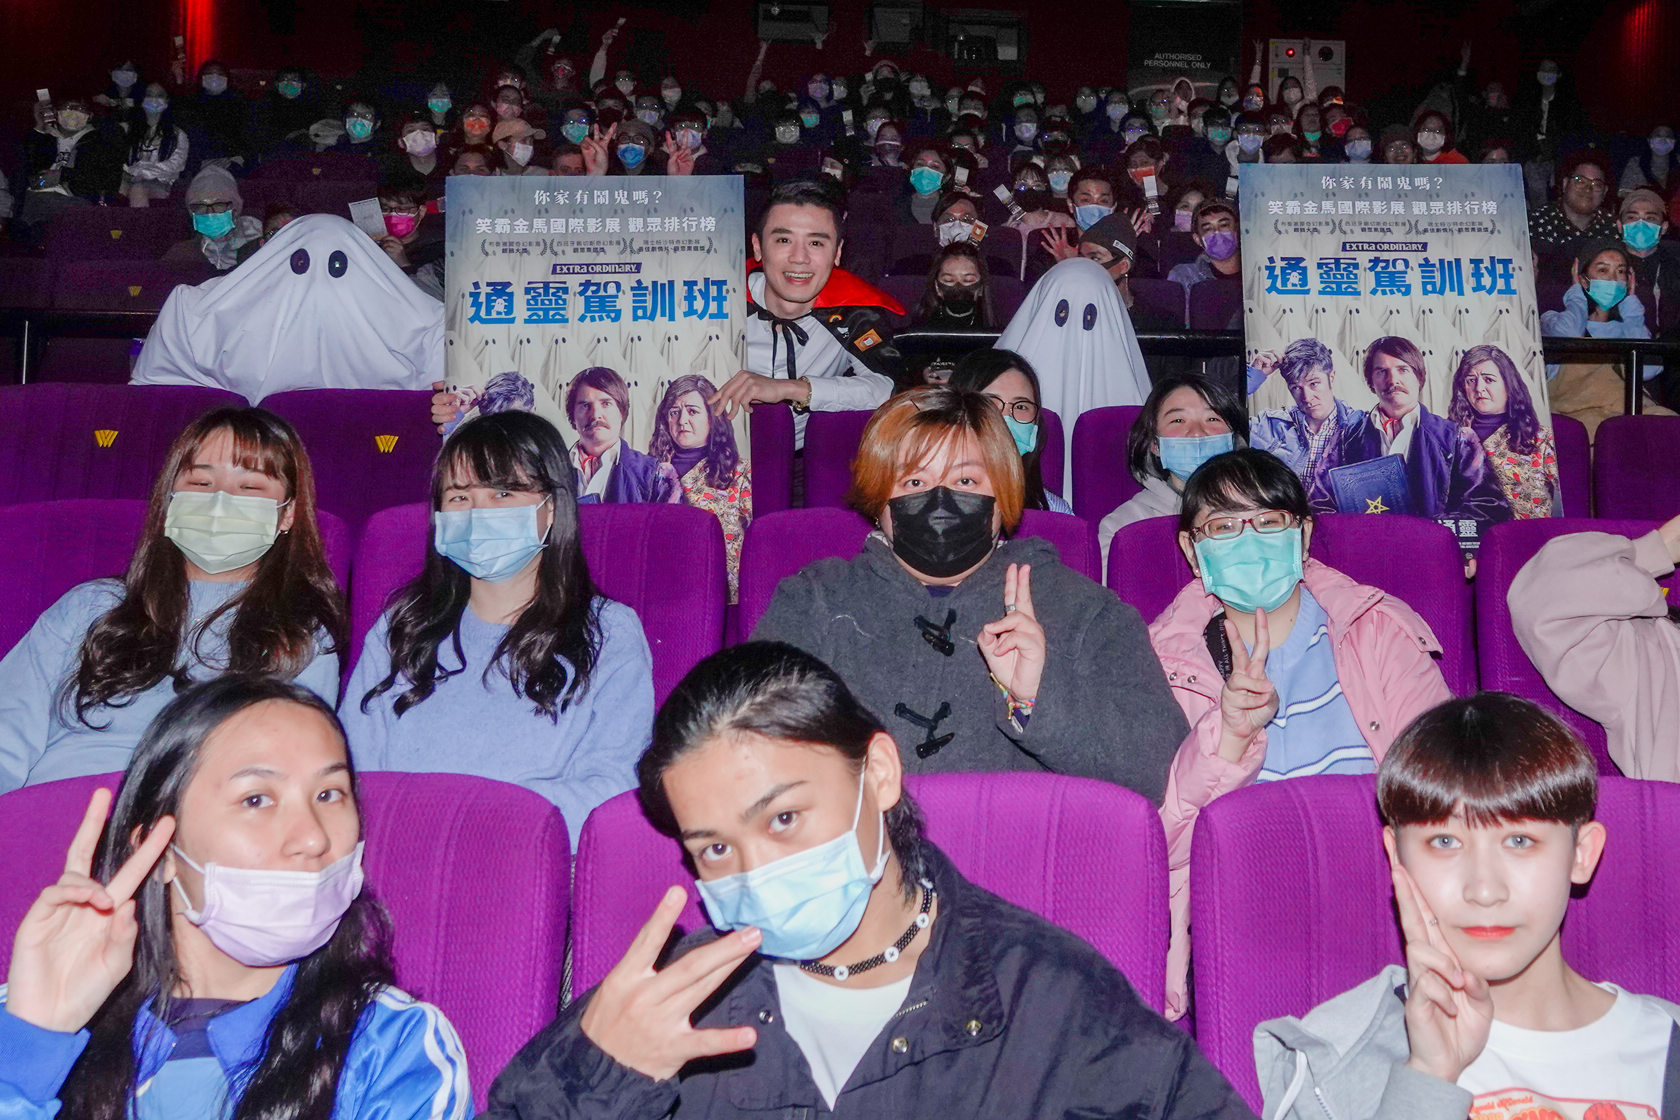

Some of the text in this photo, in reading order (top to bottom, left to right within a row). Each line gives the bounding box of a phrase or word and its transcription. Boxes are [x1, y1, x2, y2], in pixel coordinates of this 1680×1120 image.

[1144, 60, 1211, 69] PERSONNEL ONLY
[1154, 53, 1202, 61] AUTHORISED
[1268, 200, 1498, 216] 笑霸金馬國際影展 觀眾排行榜
[476, 216, 717, 234] 笑霸金馬國際影展 觀眾排行榜
[1264, 256, 1517, 296] 通靈駕訓班
[468, 277, 729, 325] 通靈駕訓班
